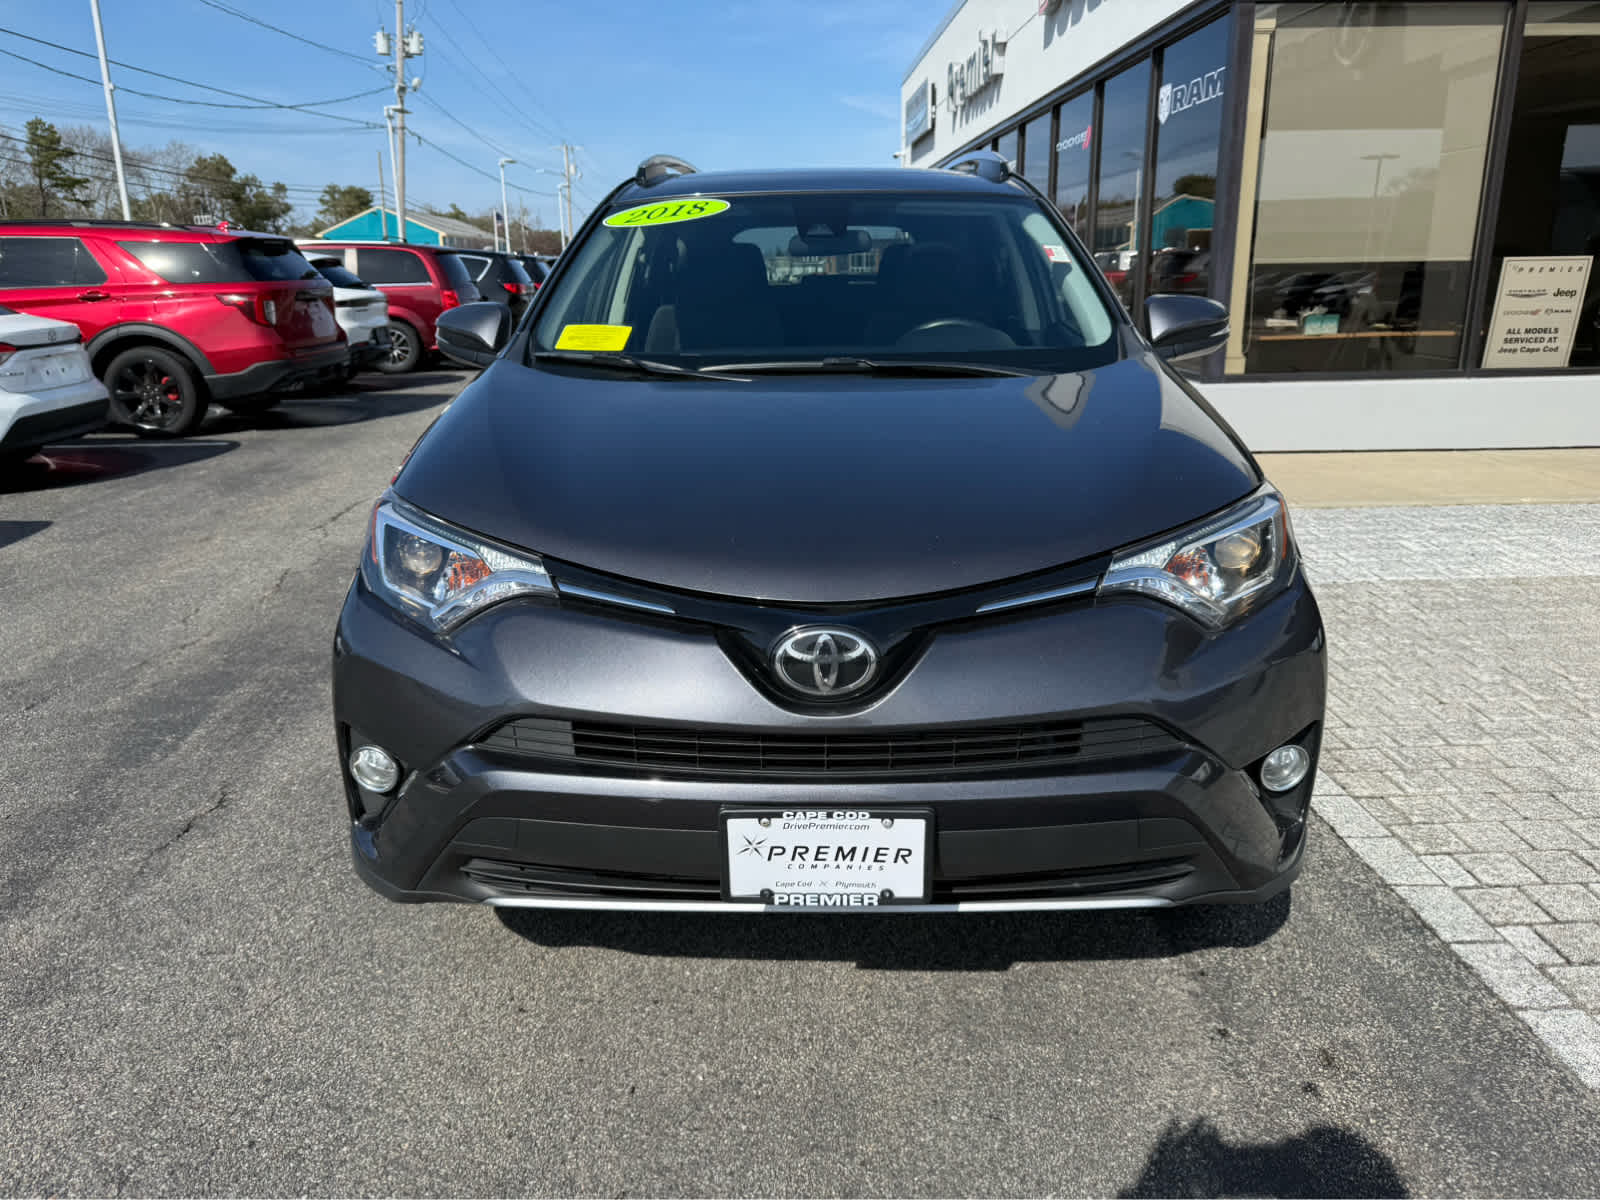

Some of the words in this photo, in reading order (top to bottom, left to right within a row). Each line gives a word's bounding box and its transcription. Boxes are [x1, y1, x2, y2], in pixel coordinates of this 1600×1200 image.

[1171, 66, 1226, 114] RAM
[1056, 130, 1088, 152] DODGE
[624, 201, 709, 223] 2018
[1553, 288, 1577, 298] Jeep
[1524, 327, 1559, 335] MODELS
[1519, 346, 1540, 354] Cape
[782, 811, 827, 820] CAPE
[832, 811, 870, 820] COD
[783, 822, 870, 831] DrivePremier.com
[767, 845, 913, 865] PREMIER
[835, 881, 877, 889] Plymouth
[774, 893, 879, 906] PREMIER
